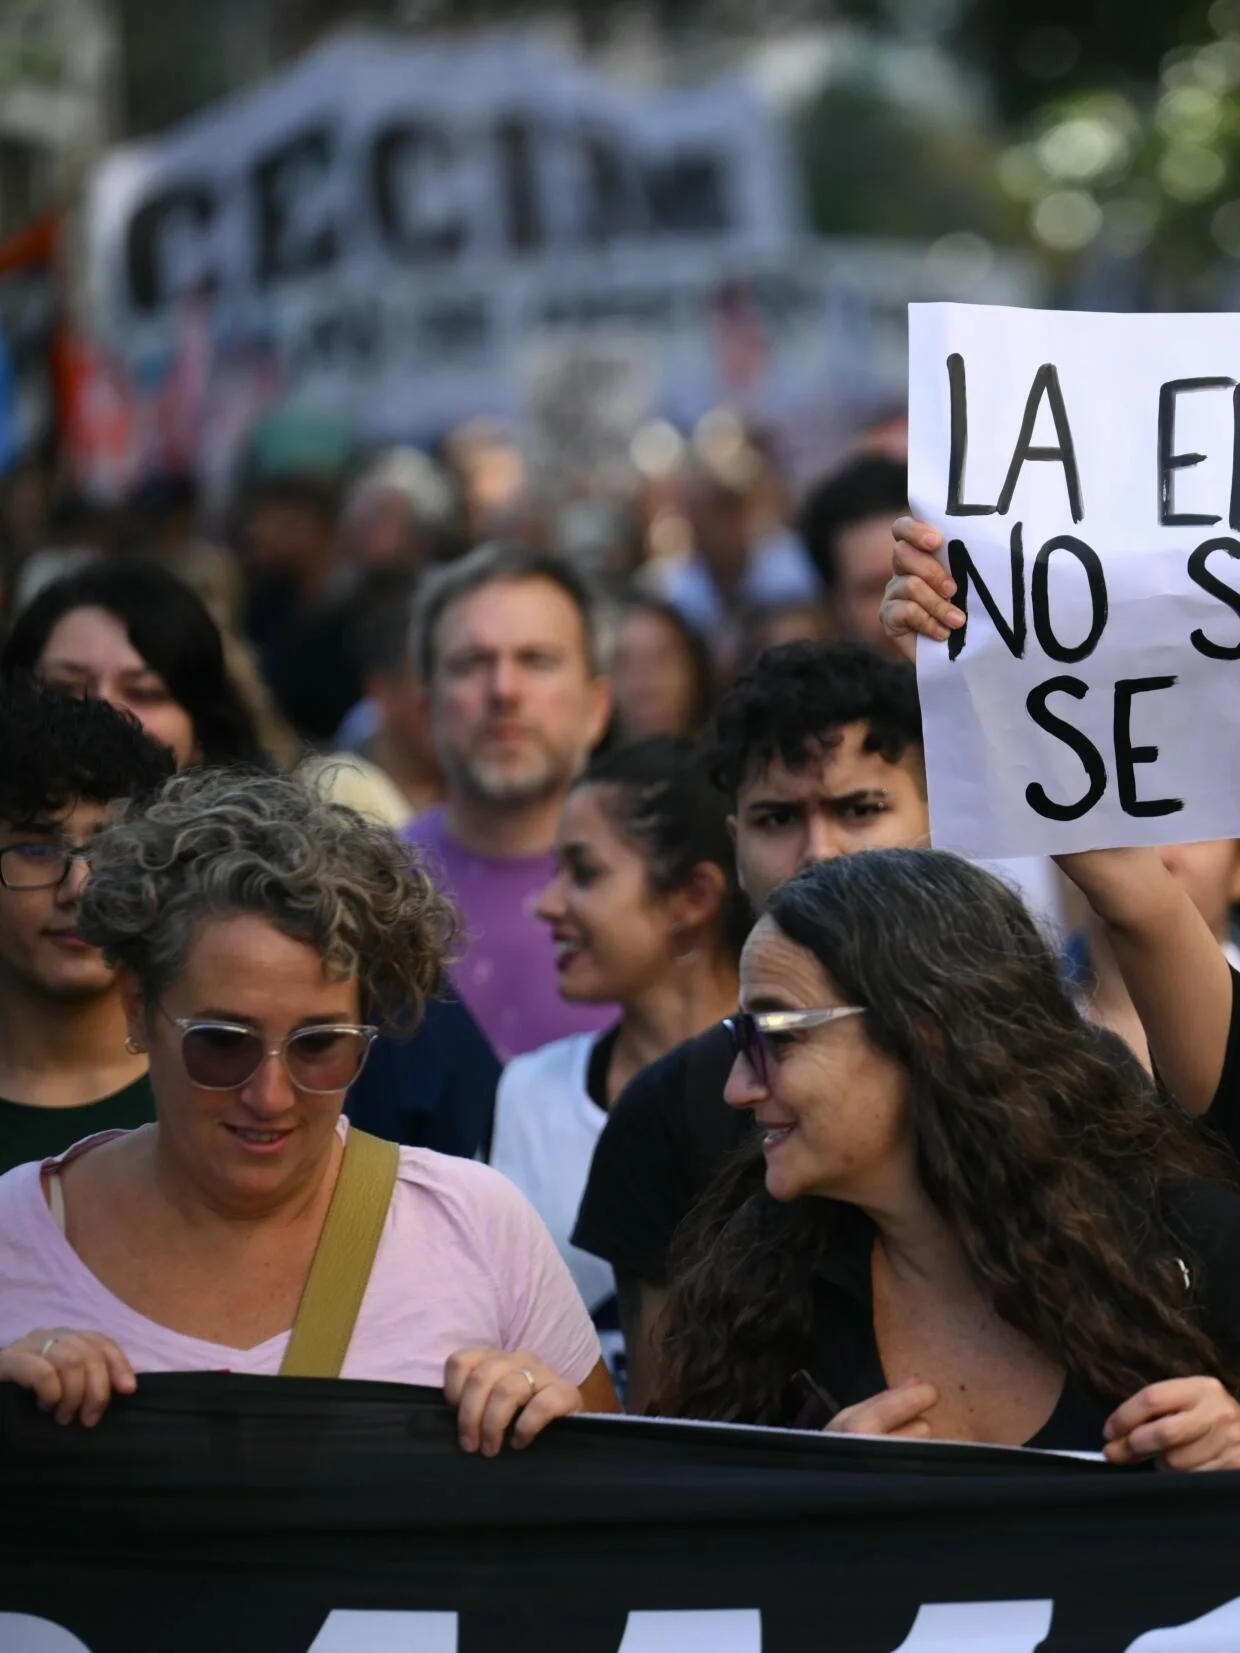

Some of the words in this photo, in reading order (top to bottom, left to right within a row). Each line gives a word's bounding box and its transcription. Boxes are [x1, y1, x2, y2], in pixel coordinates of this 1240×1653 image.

[945, 352, 1084, 524] LA
[948, 521, 1109, 664] NO
[1025, 675, 1185, 821] SE
